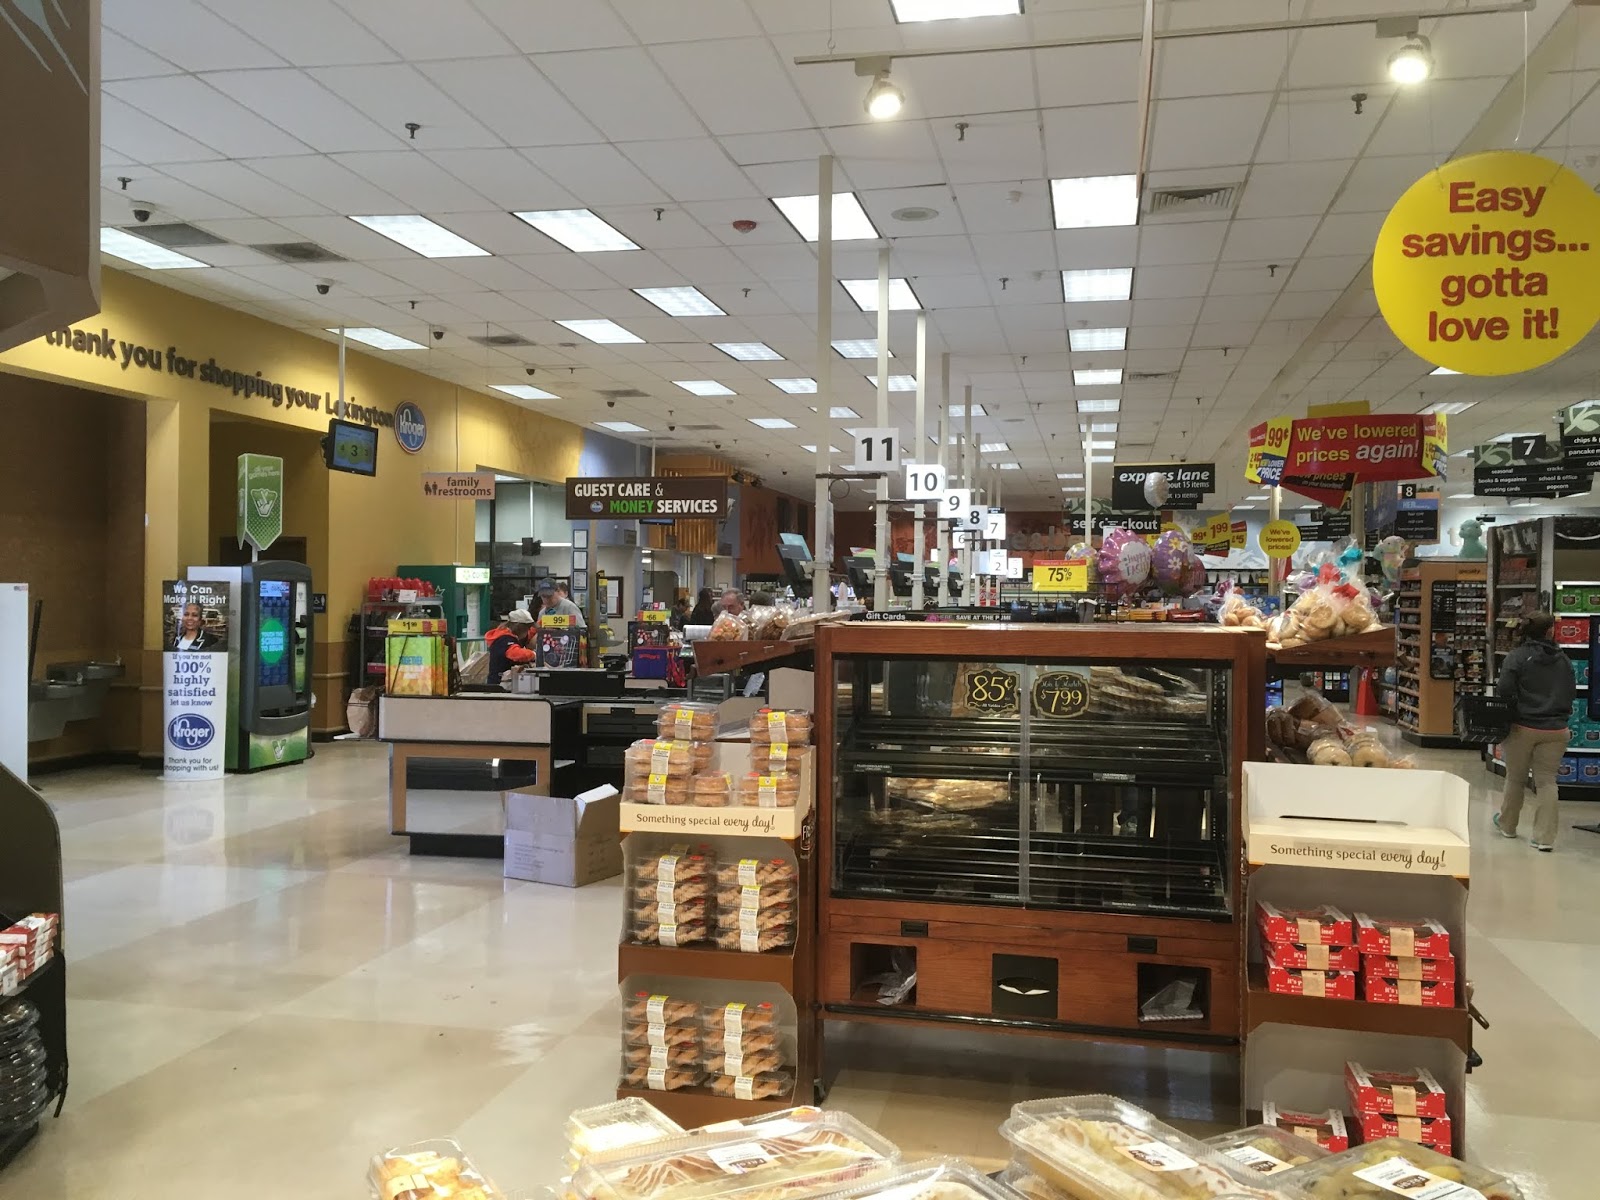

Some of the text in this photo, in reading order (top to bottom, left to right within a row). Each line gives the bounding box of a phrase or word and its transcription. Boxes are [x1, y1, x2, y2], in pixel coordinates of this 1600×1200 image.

[1449, 181, 1546, 217] Easy
[1402, 224, 1590, 261] savings...
[1441, 267, 1548, 306] gotta
[1428, 307, 1559, 342] love it!
[119, 341, 162, 371] you
[166, 346, 198, 378] for
[200, 358, 284, 408] shopping
[285, 386, 322, 410] your
[400, 408, 425, 446] Kroger
[1297, 423, 1417, 441] We've lowered
[1574, 436, 1590, 444] chips
[351, 444, 358, 457] 3
[860, 437, 893, 461] 11
[1297, 440, 1419, 467] prices again!
[1523, 439, 1536, 456] 7
[1119, 468, 1210, 484] expss lane
[1260, 467, 1282, 480] PRICE
[447, 476, 480, 489] family
[909, 471, 938, 492] 10
[1182, 481, 1190, 489] 15
[1191, 480, 1210, 488] items
[438, 486, 492, 496] restrooms
[574, 483, 664, 497] GUEST CARE &
[1405, 486, 1413, 497] 8
[610, 499, 718, 513] MONEY SERVICES
[949, 495, 961, 511] 9
[970, 511, 980, 524] 8
[1073, 518, 1158, 530] sef cckout
[990, 522, 998, 534] 7
[958, 534, 965, 543] 6
[995, 562, 1001, 571] 2
[1013, 567, 1018, 575] 3
[1048, 567, 1072, 582] 75%
[173, 584, 213, 594] We Can
[163, 594, 227, 605] Make It Right
[865, 612, 906, 620] Gift Cards
[179, 653, 199, 661] you're
[174, 661, 212, 674] 100%
[173, 675, 210, 687] highly
[168, 687, 217, 697] satisfied
[972, 675, 1013, 702] 85¢
[173, 718, 211, 746] Kroger
[164, 764, 192, 773] hopping
[189, 758, 201, 766] you
[636, 814, 775, 833] Something special every day!
[1270, 844, 1446, 871] Something special every day!
